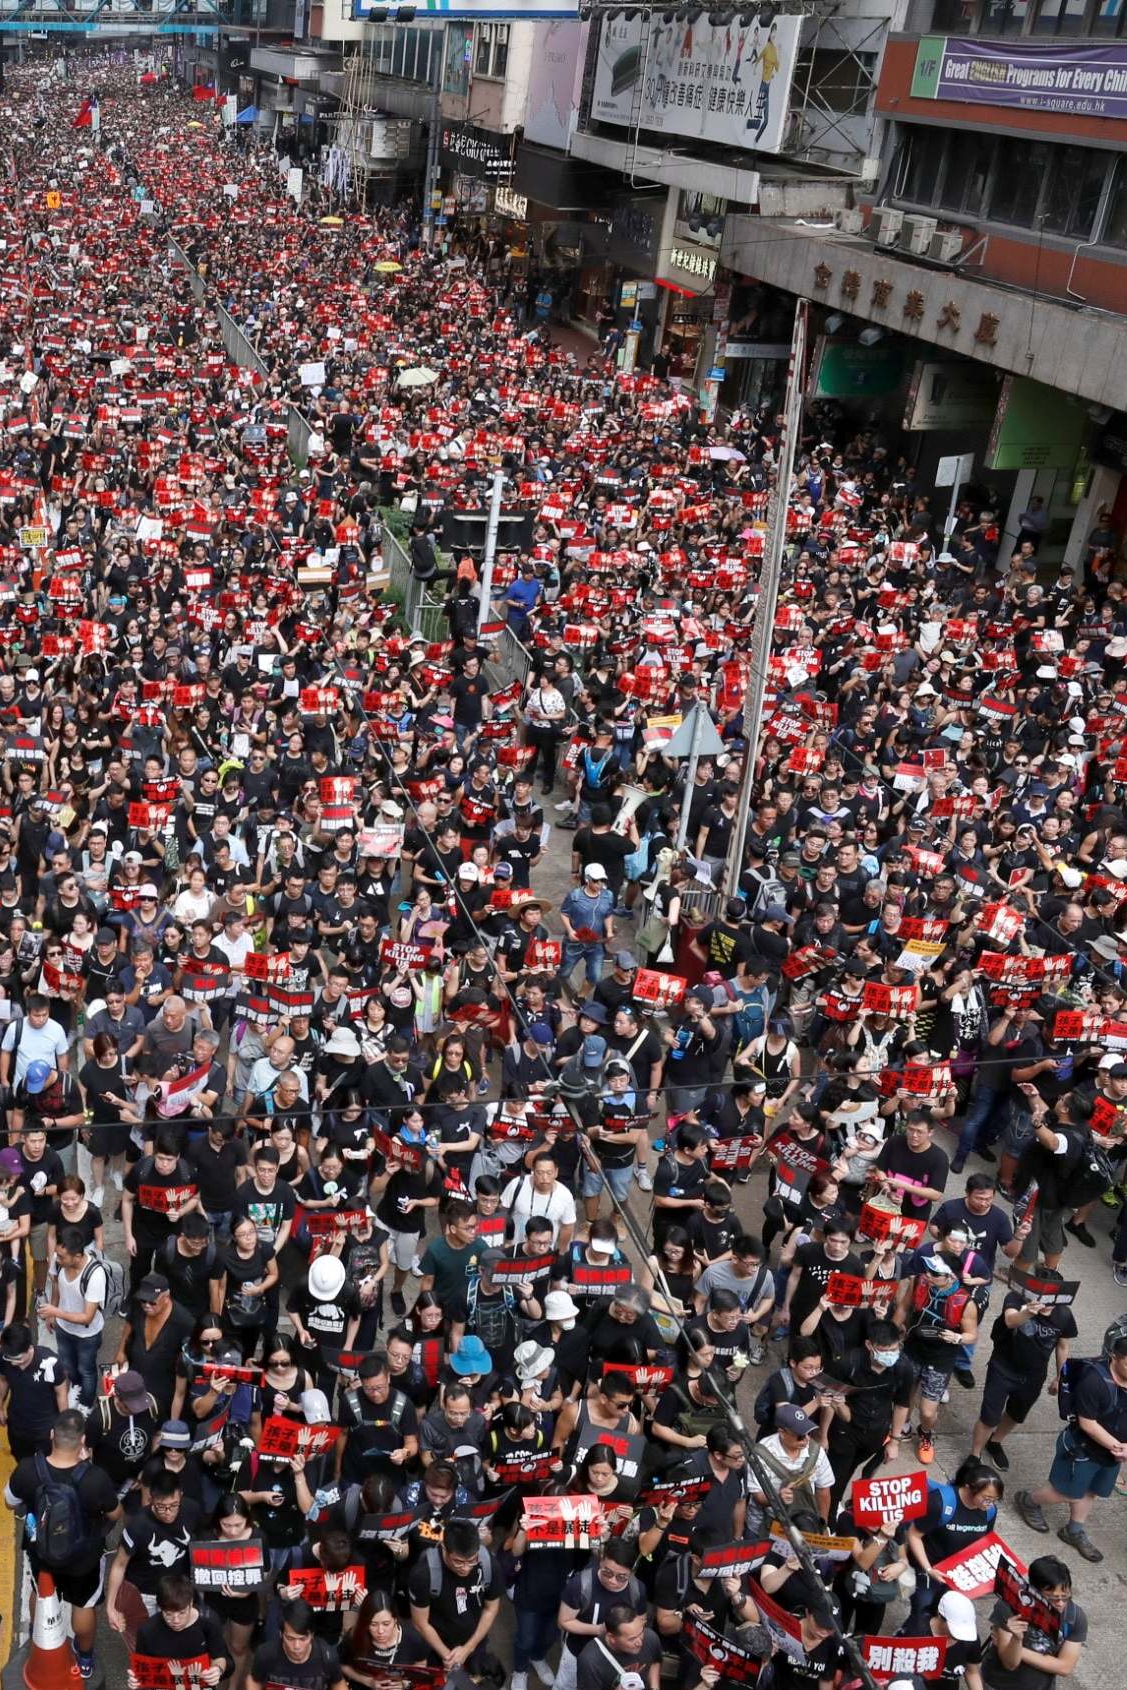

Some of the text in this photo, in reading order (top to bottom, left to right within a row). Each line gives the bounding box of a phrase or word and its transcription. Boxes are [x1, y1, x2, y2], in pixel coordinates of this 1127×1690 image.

[919, 60, 937, 77] 1/F
[944, 58, 970, 81] Great
[969, 61, 1008, 83] ENGLISH
[1006, 65, 1055, 89] Programs
[1055, 68, 1073, 88] for
[1073, 69, 1107, 92] Every
[1019, 95, 1105, 112] www.i-square.edu.hk
[795, 650, 815, 658] STOP
[771, 720, 807, 739] KILLING
[780, 716, 803, 728] STOP
[384, 948, 425, 962] KILLING
[392, 942, 420, 952] STOP
[774, 1142, 817, 1173] KILLING
[786, 1142, 818, 1164] STOP
[869, 1478, 912, 1497] STOP
[528, 1503, 557, 1513] 孩子
[859, 1490, 922, 1511] KILLING
[882, 1508, 904, 1524] US
[194, 1567, 262, 1585] 撤回控罪
[868, 1645, 940, 1673] 別殺我
